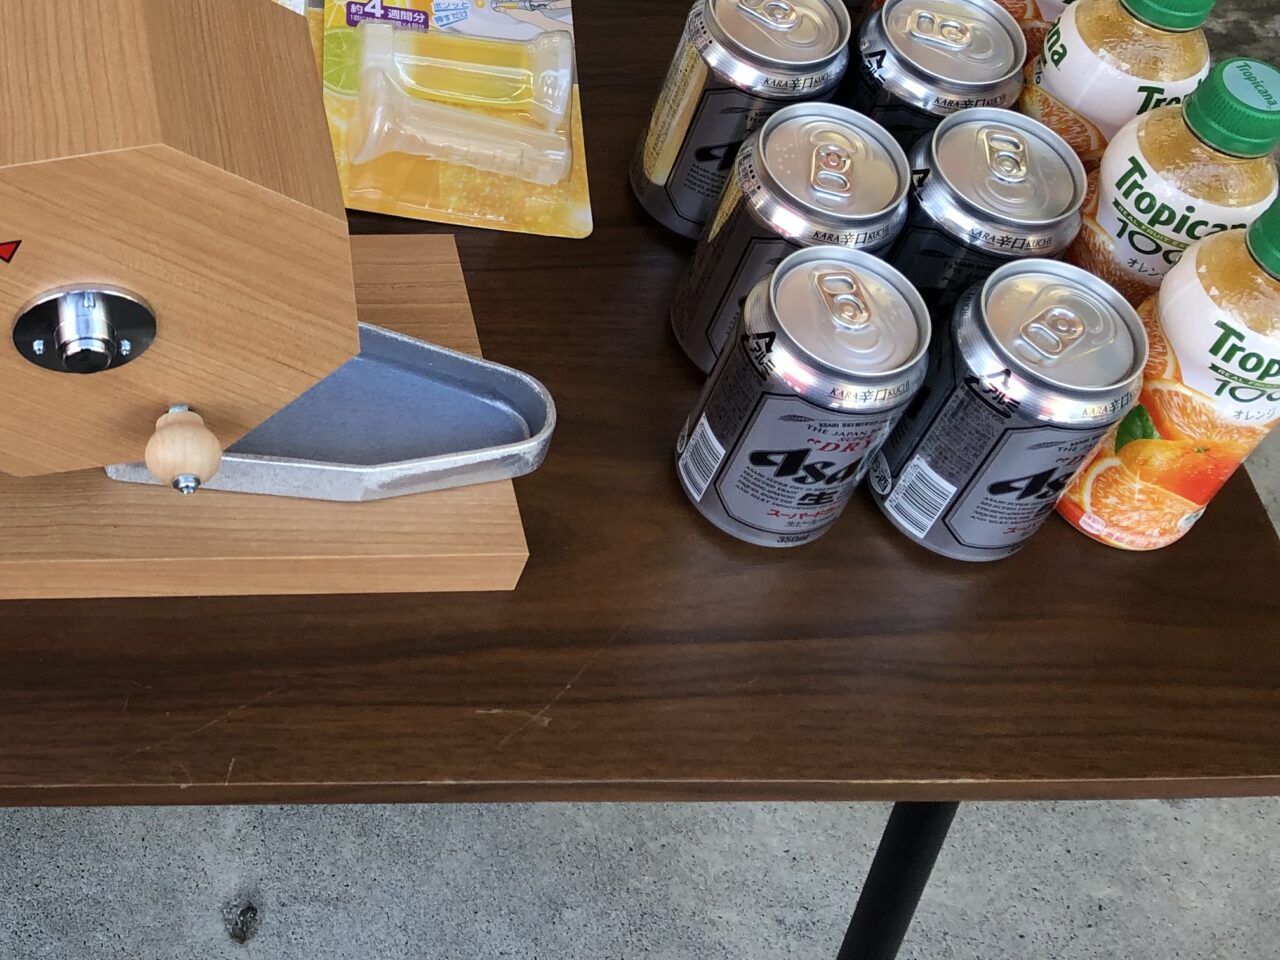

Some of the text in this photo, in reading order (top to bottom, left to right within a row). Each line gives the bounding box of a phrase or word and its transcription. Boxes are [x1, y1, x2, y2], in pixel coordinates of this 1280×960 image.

[1236, 61, 1279, 107] Tropicana
[1117, 218, 1183, 265] 100
[1218, 369, 1244, 384] REAL
